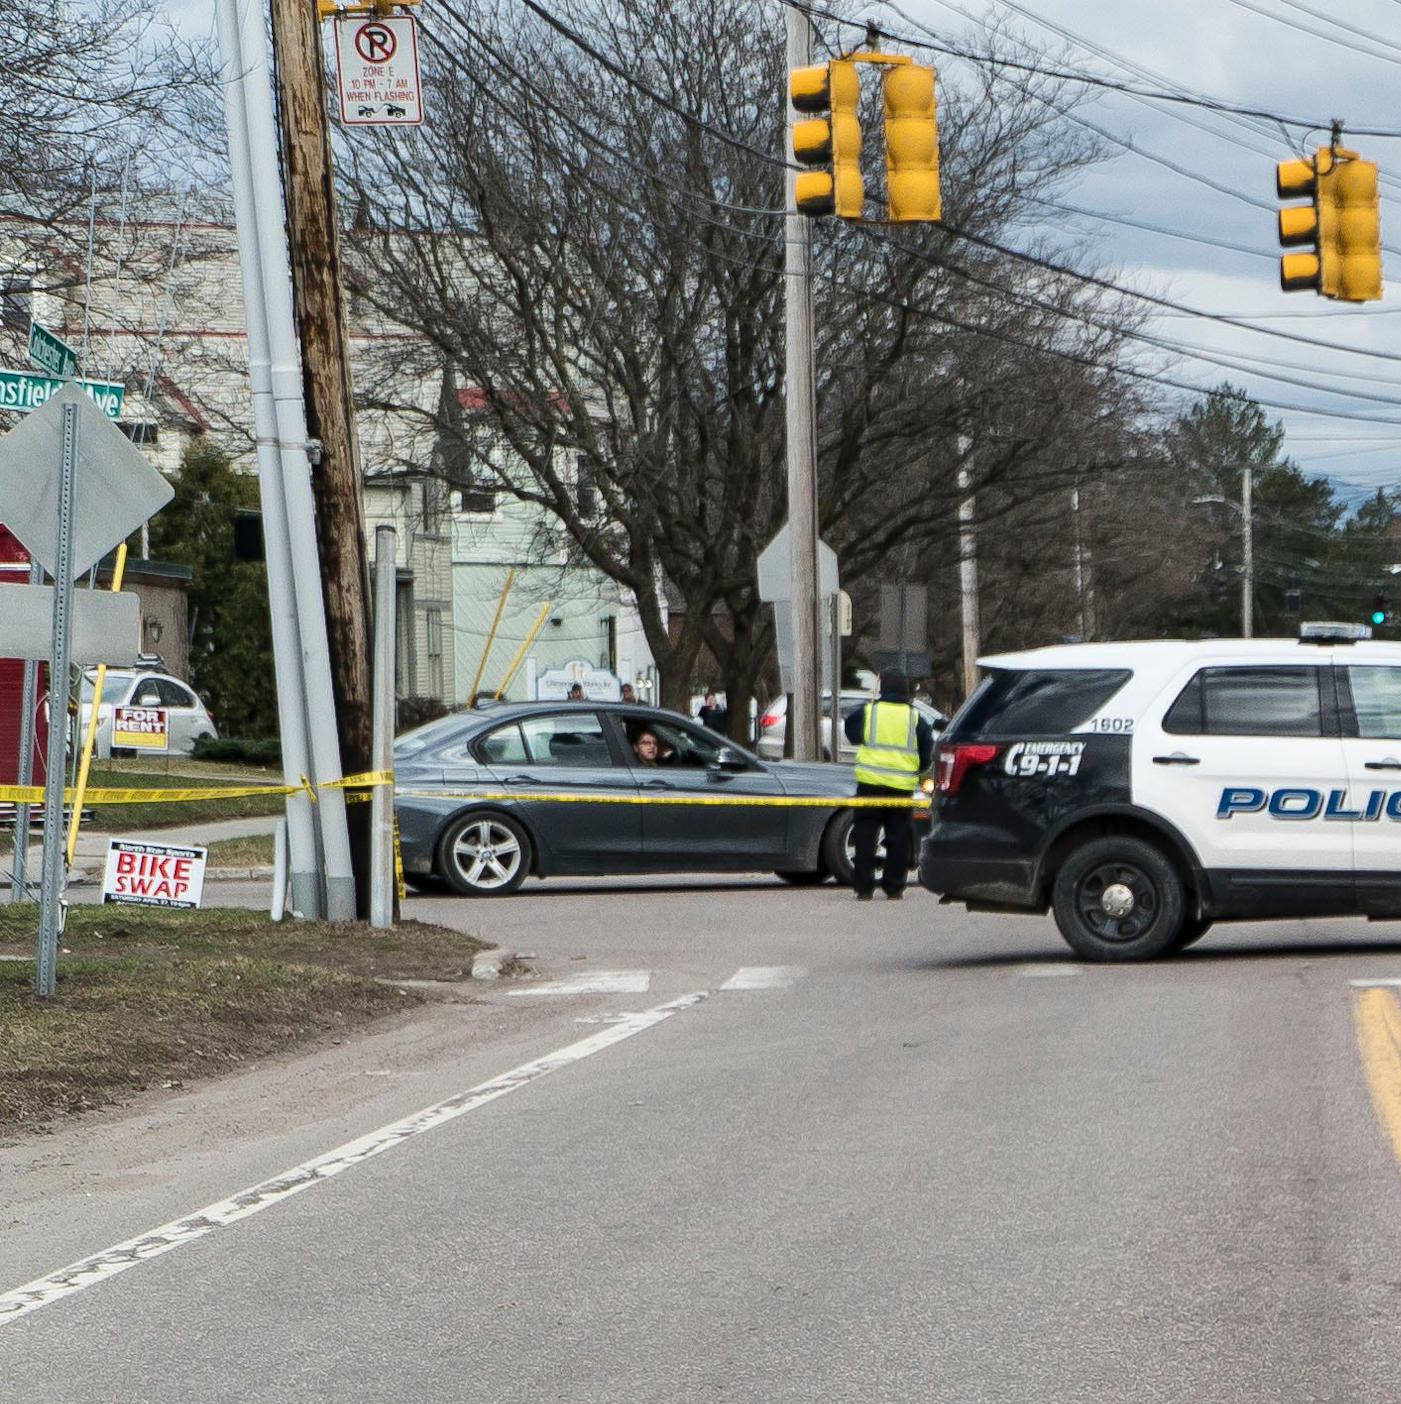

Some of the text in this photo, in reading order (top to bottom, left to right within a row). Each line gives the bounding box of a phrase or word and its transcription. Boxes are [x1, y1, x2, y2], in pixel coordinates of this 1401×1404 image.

[362, 66, 395, 78] ZONE E
[351, 80, 360, 89] 10
[364, 79, 376, 90] PM
[387, 79, 393, 90] 7
[396, 78, 409, 89] AM
[346, 91, 415, 101] WHEN FLASHING
[0, 376, 63, 407] nsfiel
[122, 710, 159, 721] FOR
[116, 720, 164, 733] RENT
[1024, 742, 1087, 755] EMERGENCY
[1020, 755, 1081, 776] 9-1-1
[116, 853, 192, 880] BIKE
[115, 876, 189, 898] SWAP
